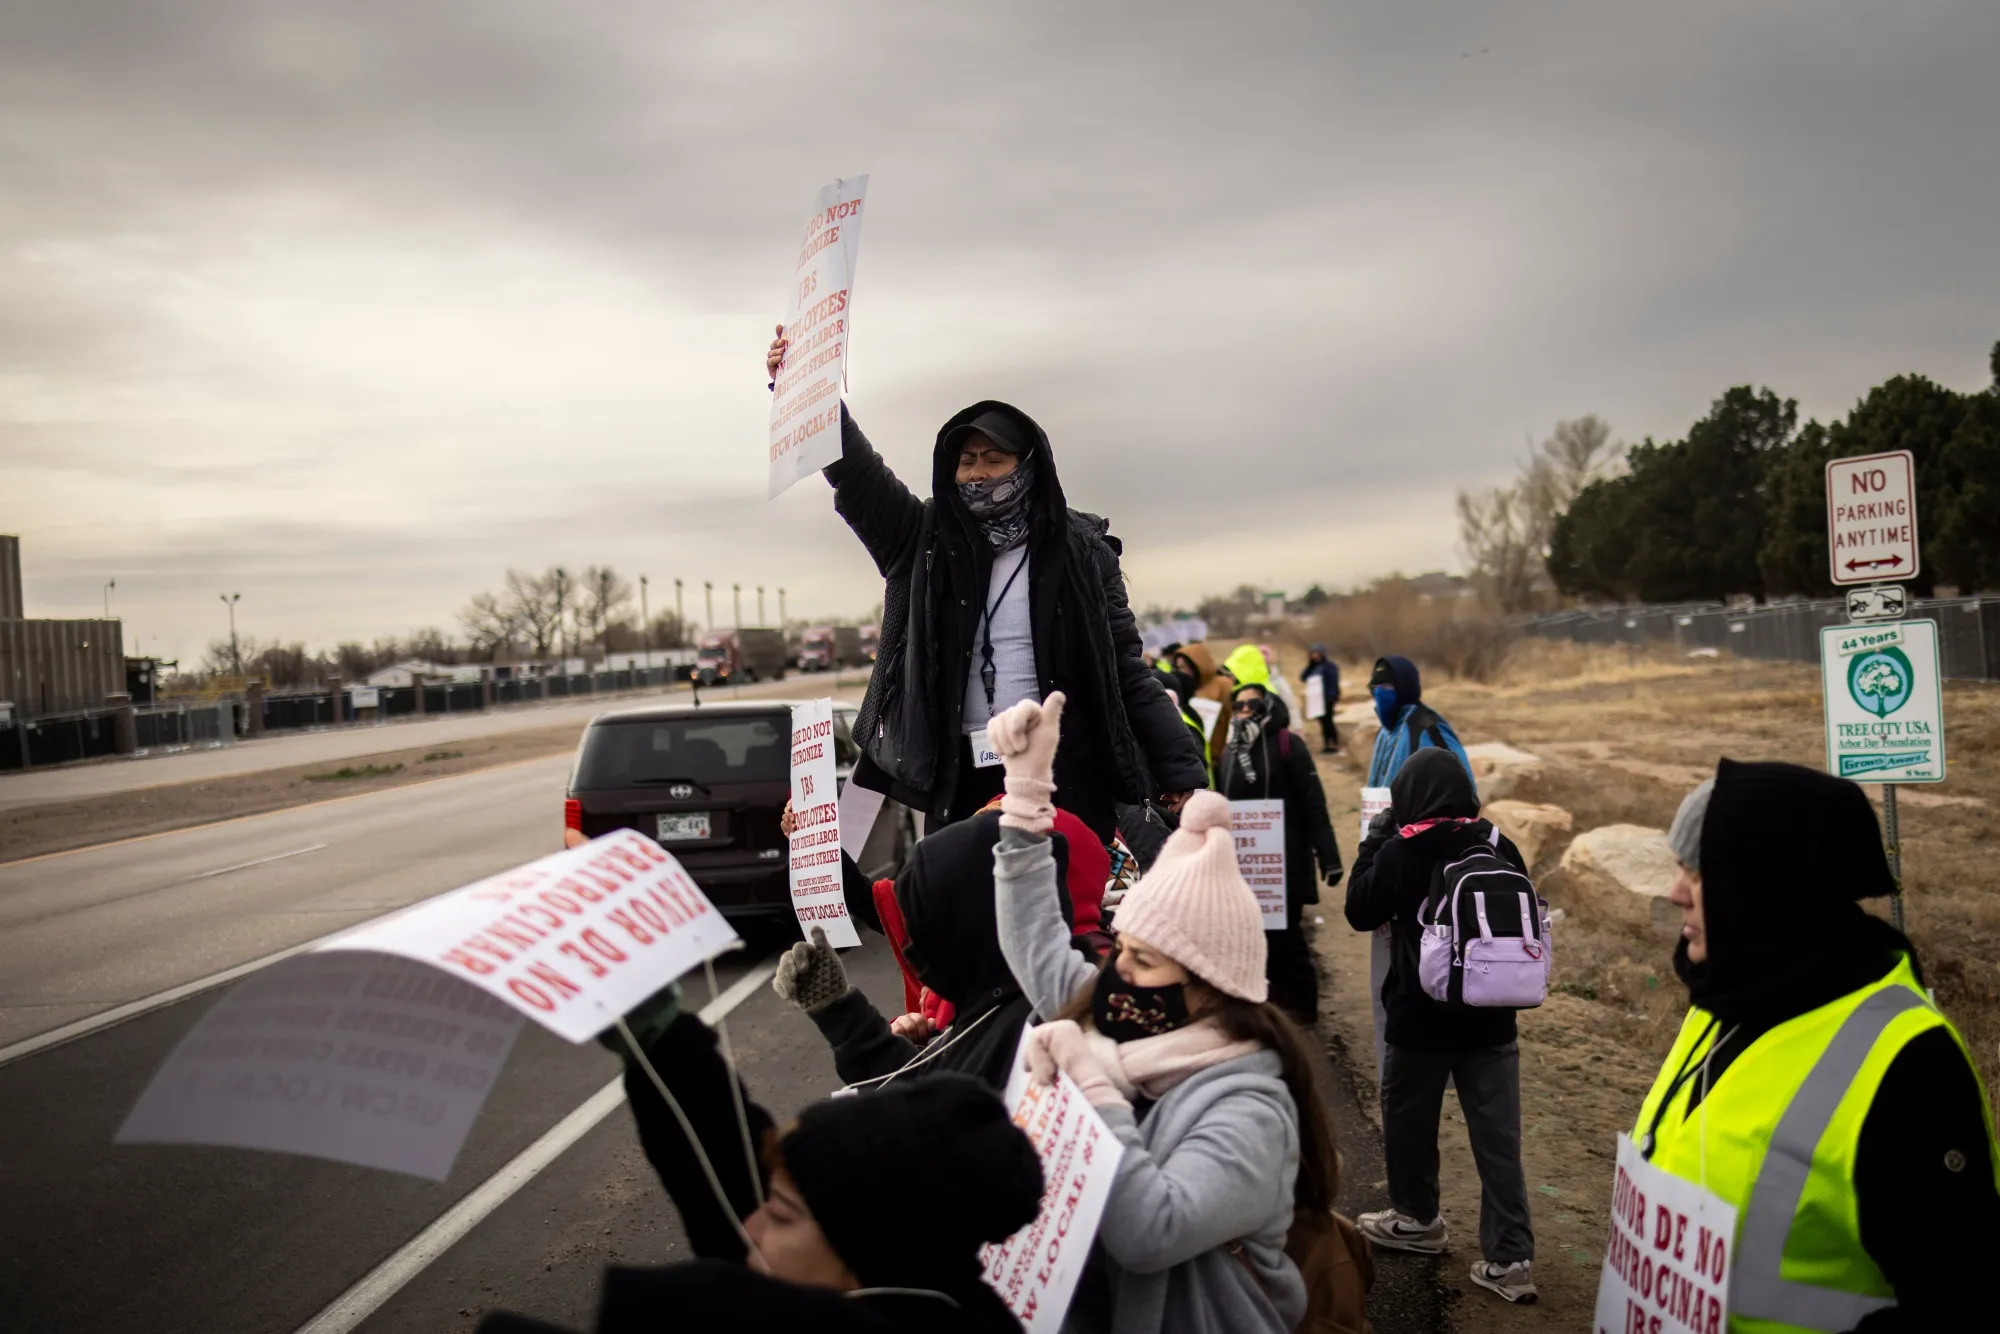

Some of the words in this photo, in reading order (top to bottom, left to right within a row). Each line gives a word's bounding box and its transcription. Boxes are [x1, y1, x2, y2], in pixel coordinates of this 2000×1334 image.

[810, 212, 824, 238] DO
[826, 199, 861, 224] NOT
[797, 268, 818, 310] JBS
[785, 289, 847, 350] MPLOYEES
[812, 319, 844, 350] LABOR
[808, 341, 841, 374] STRIKE
[770, 433, 791, 463] UFCW
[793, 412, 825, 446] LOCAL
[827, 404, 838, 427] #7
[1852, 470, 1886, 495] NO
[1836, 499, 1906, 523] PARKING
[1835, 526, 1909, 549] ANYTIME
[1841, 639, 1857, 651] 44
[1859, 631, 1897, 646] Years
[802, 726, 812, 743] DO
[813, 720, 831, 739] NOT
[1837, 723, 1869, 737] TREE
[1871, 722, 1902, 736] CITY
[1905, 721, 1931, 734] USA
[1838, 739, 1861, 748] Arbor
[1864, 738, 1878, 749] Day
[1882, 735, 1931, 747] Foundation
[1844, 757, 1884, 770] Growth
[1888, 754, 1921, 766] Award
[800, 775, 814, 801] JBS
[1244, 812, 1259, 820] DO
[1260, 811, 1281, 819] NOT
[791, 838, 800, 851] ON
[816, 829, 839, 845] LABOR
[1235, 837, 1256, 851] JBS
[791, 853, 815, 870] PRACTICE
[815, 849, 839, 865] STRIKE
[1237, 854, 1282, 864] LOYEES
[796, 907, 816, 921] UFCW
[815, 904, 839, 919] LOCAL
[838, 903, 847, 917] #7
[558, 926, 629, 979] DE
[505, 960, 582, 1013] NO
[1036, 1172, 1087, 1290] LOCAL
[1083, 1122, 1100, 1166] #7
[1654, 1203, 1689, 1262] DE
[1694, 1226, 1726, 1286] NO
